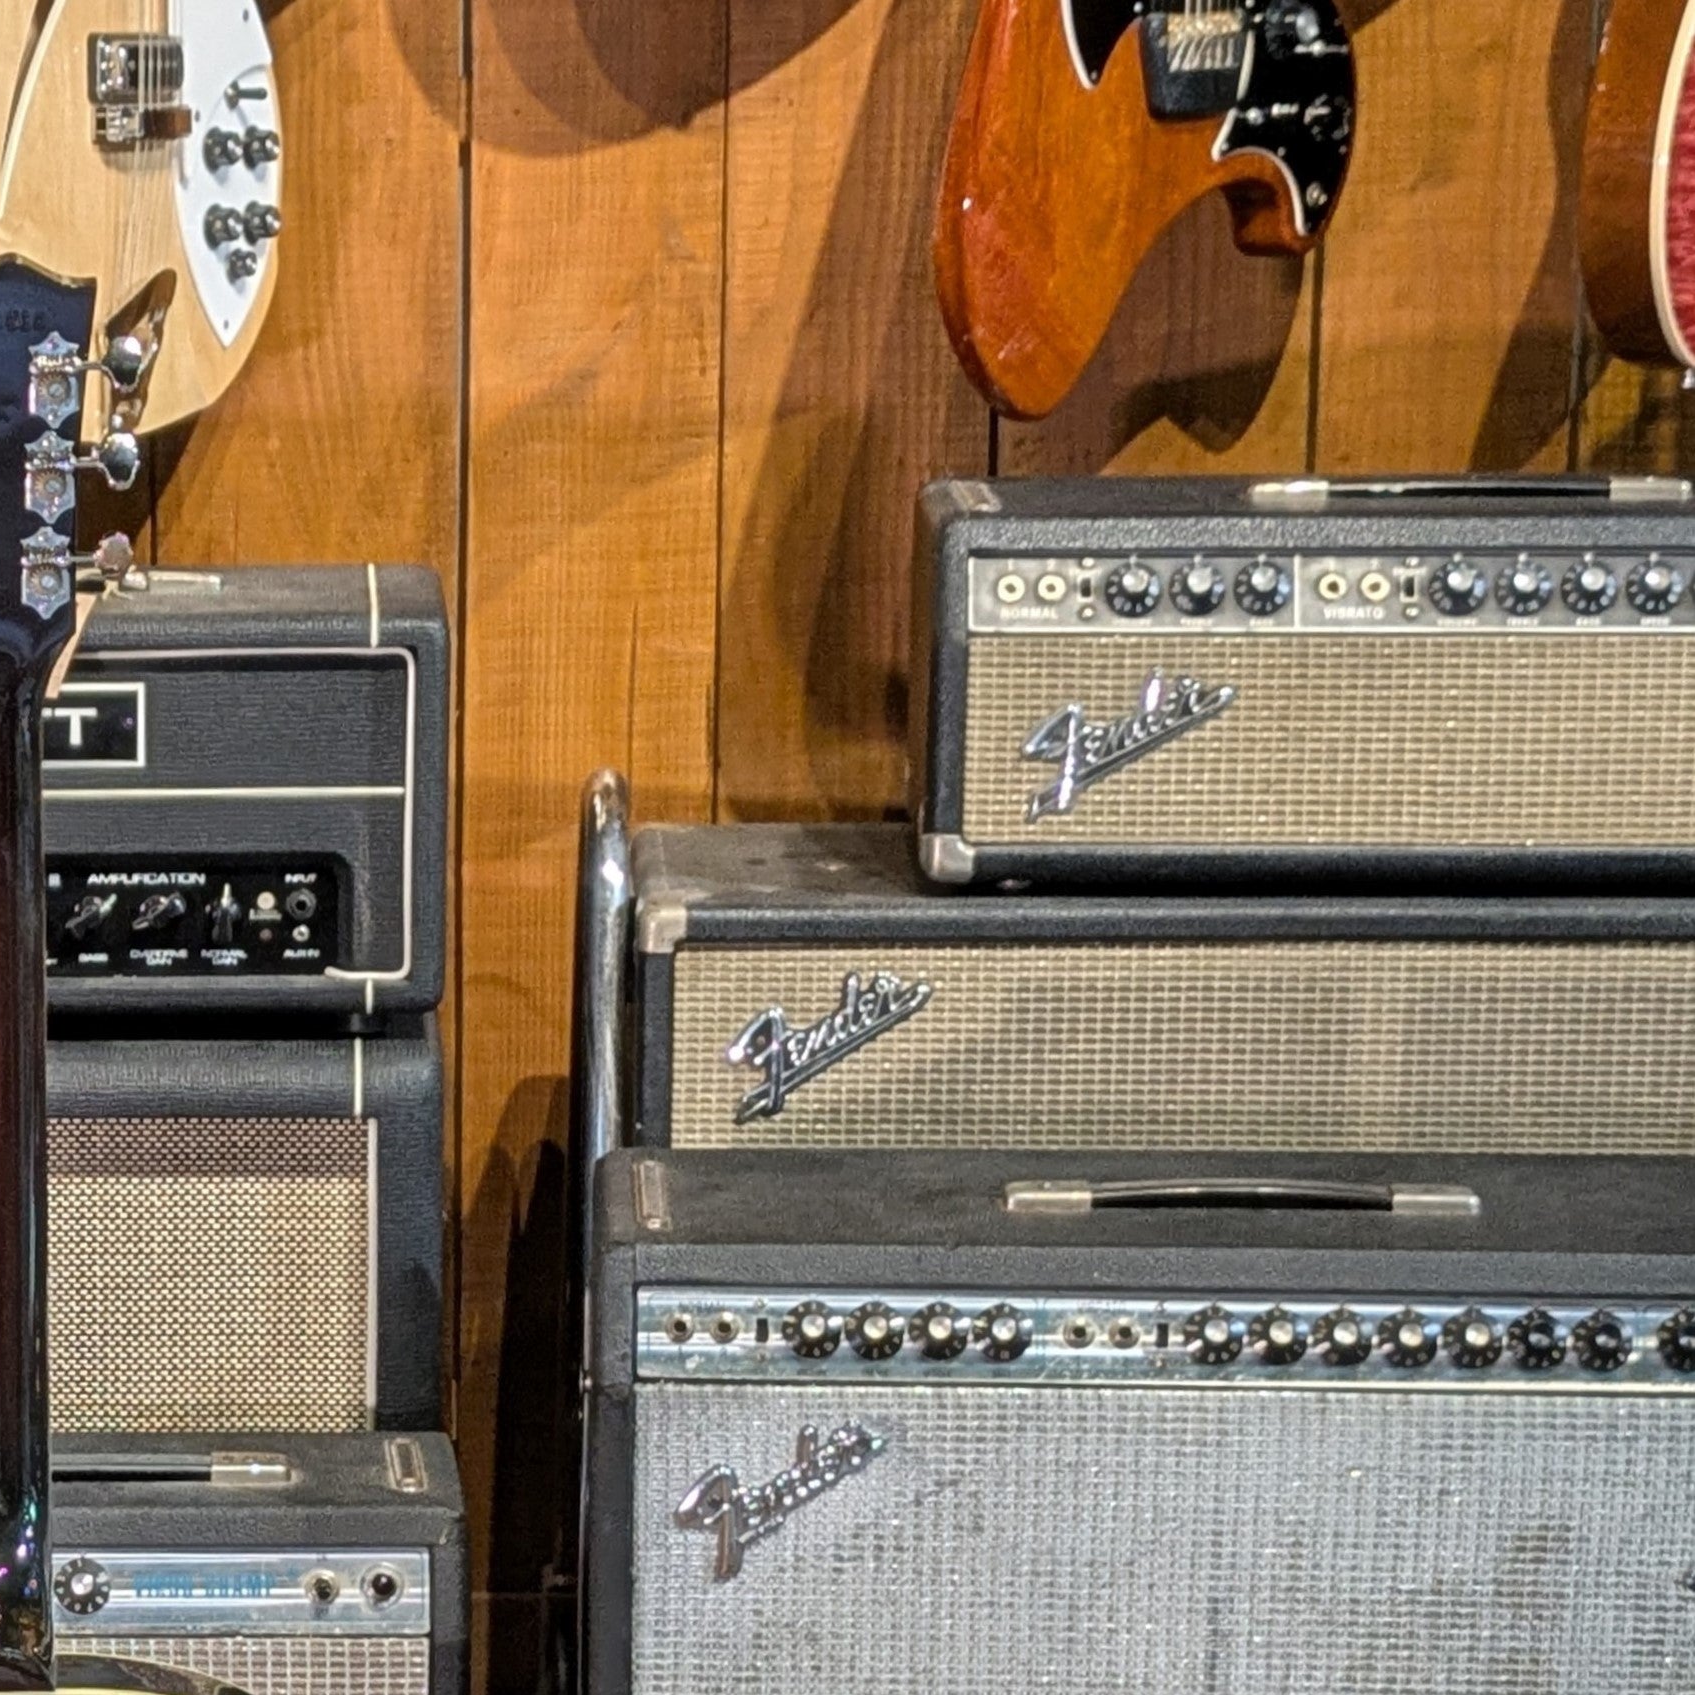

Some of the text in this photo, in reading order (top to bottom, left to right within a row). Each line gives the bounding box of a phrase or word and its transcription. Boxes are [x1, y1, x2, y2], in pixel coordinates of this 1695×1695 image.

[1000, 606, 1059, 620] NORMAL
[1323, 606, 1385, 620] VIBRATO
[1022, 666, 1237, 824] Fender
[87, 873, 206, 886] AMPLIFICATION
[725, 970, 933, 1124] Fender
[673, 1420, 889, 1582] Fender
